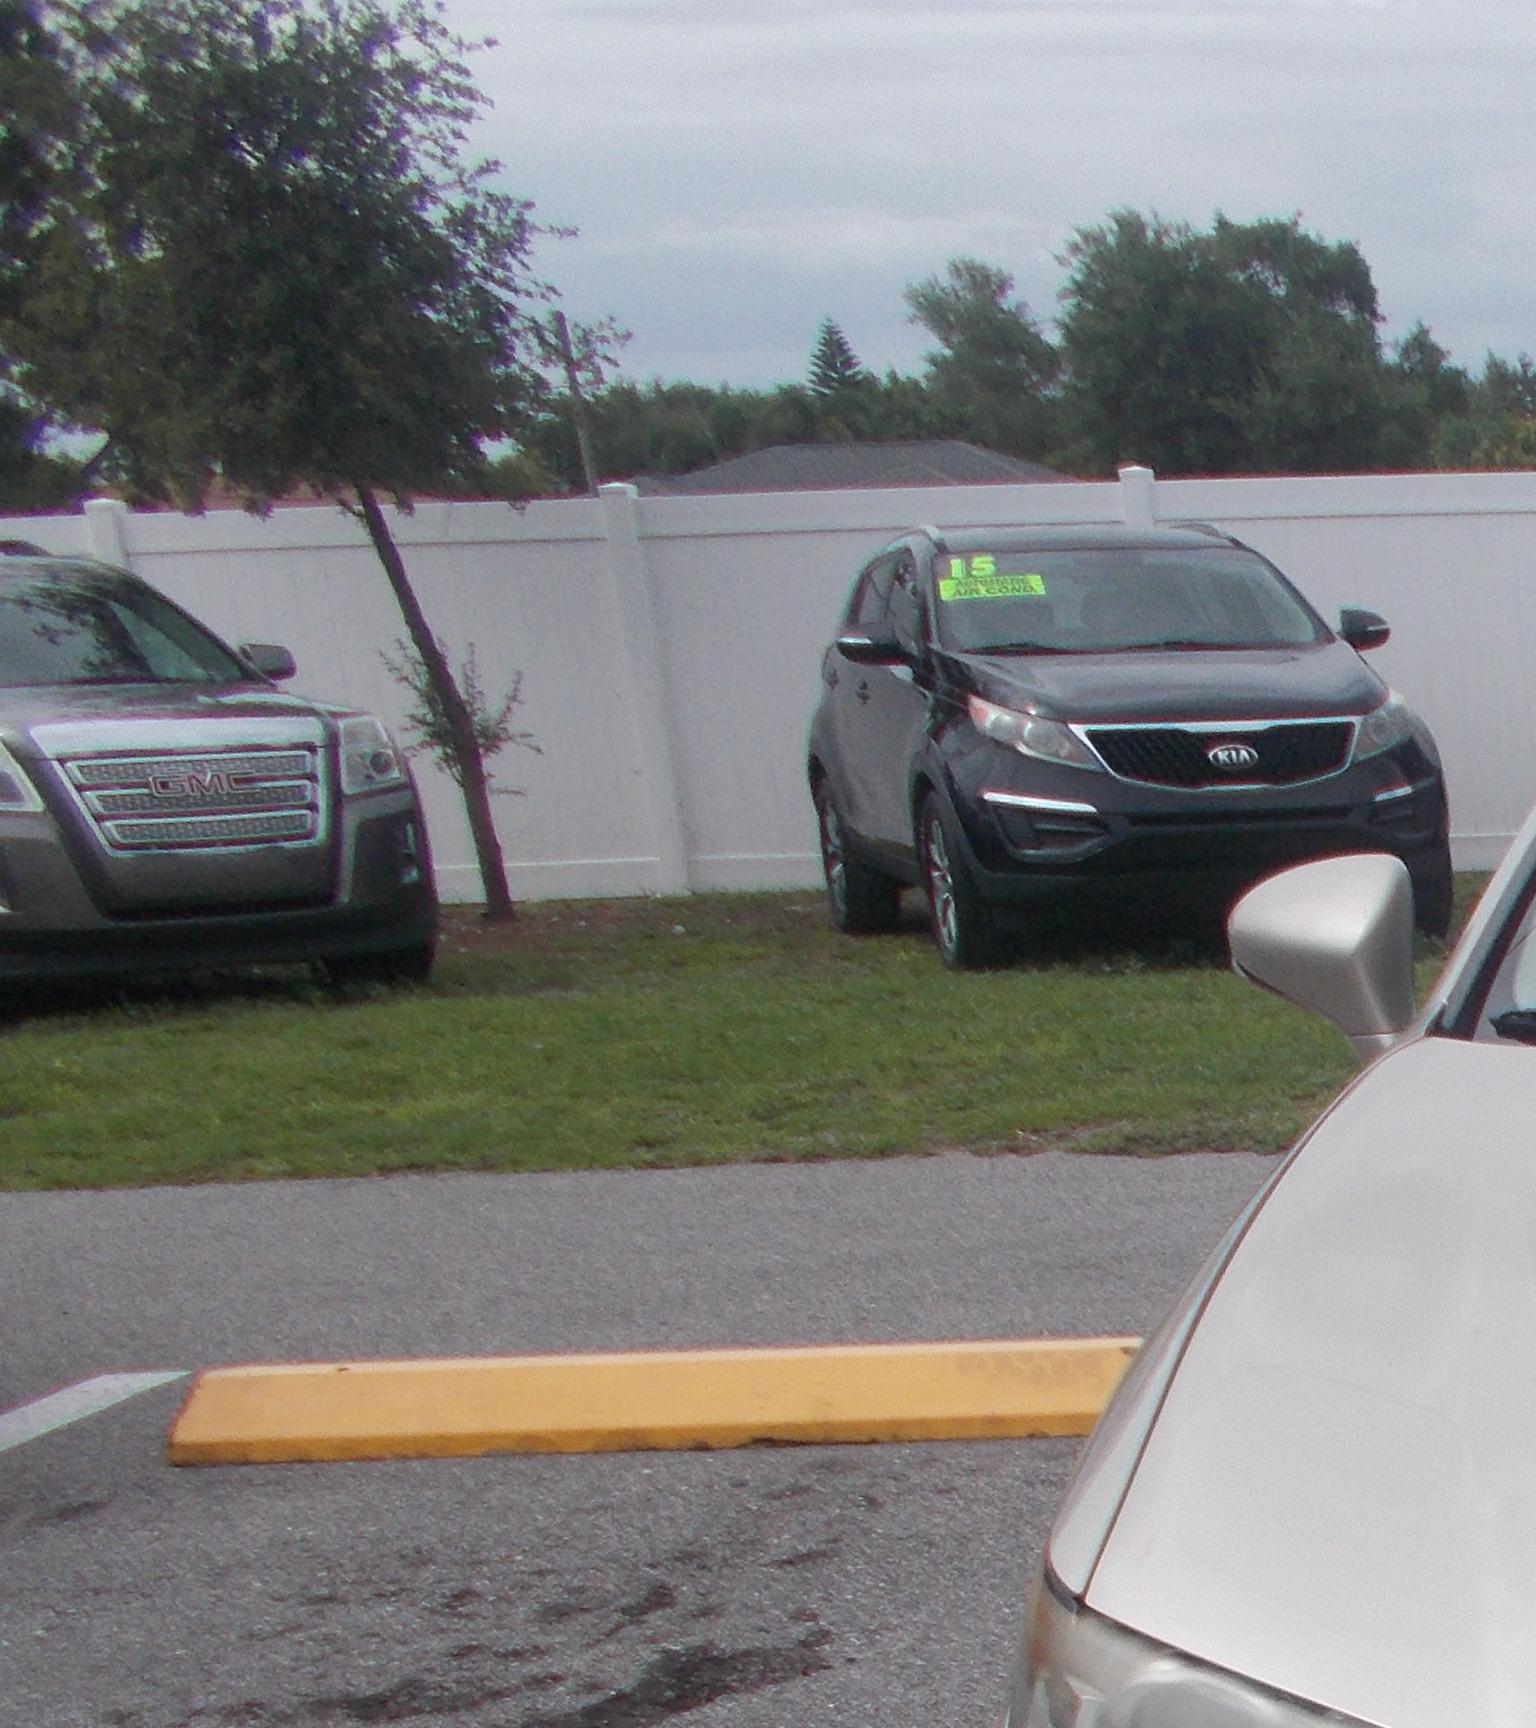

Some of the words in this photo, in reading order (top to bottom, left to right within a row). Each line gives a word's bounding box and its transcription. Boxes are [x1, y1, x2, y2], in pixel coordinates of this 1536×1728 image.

[949, 554, 997, 577] 15
[954, 586, 982, 597] AIR
[147, 767, 260, 798] GMC
